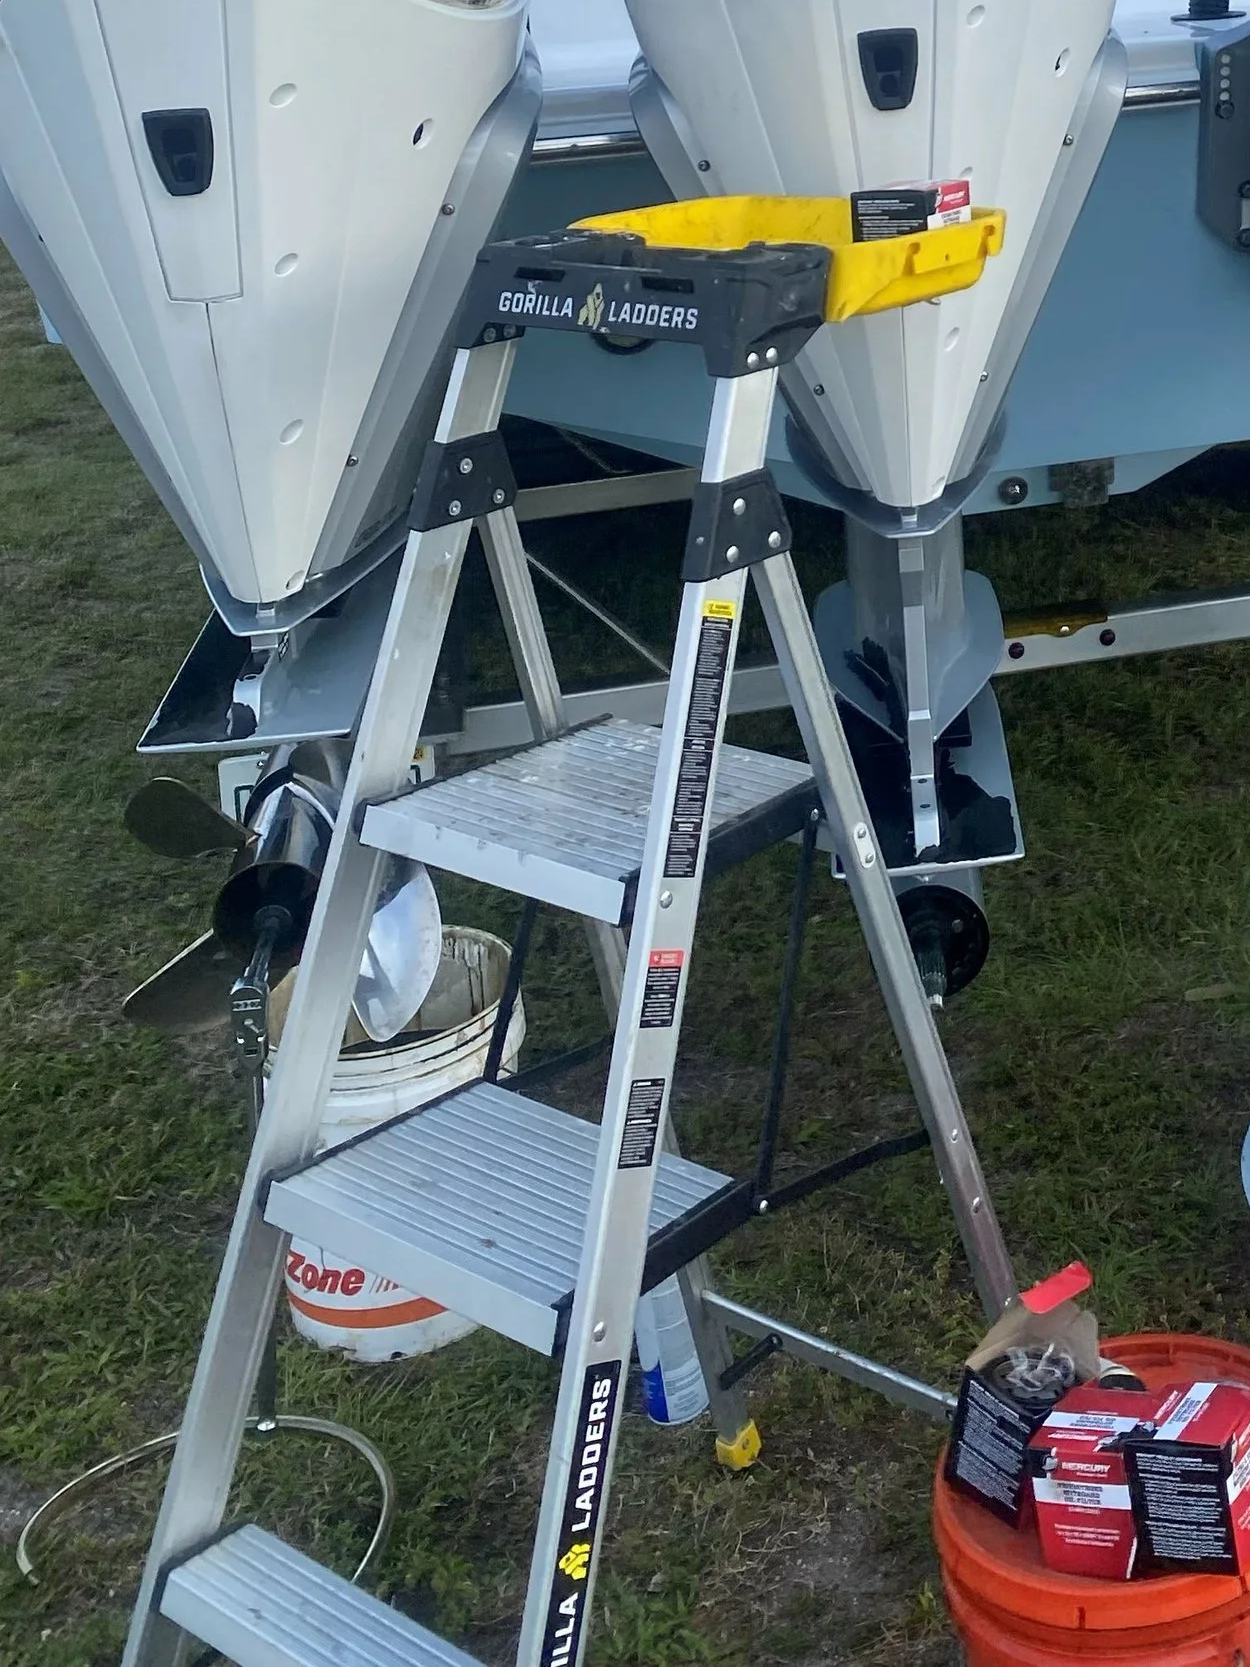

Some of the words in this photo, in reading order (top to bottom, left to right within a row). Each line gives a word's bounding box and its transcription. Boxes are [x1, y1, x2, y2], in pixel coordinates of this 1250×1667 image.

[499, 291, 574, 318] GORILLA
[607, 300, 699, 330] LADDERS
[572, 1378, 612, 1533] LADDERS
[1061, 1461, 1111, 1473] MERCURY
